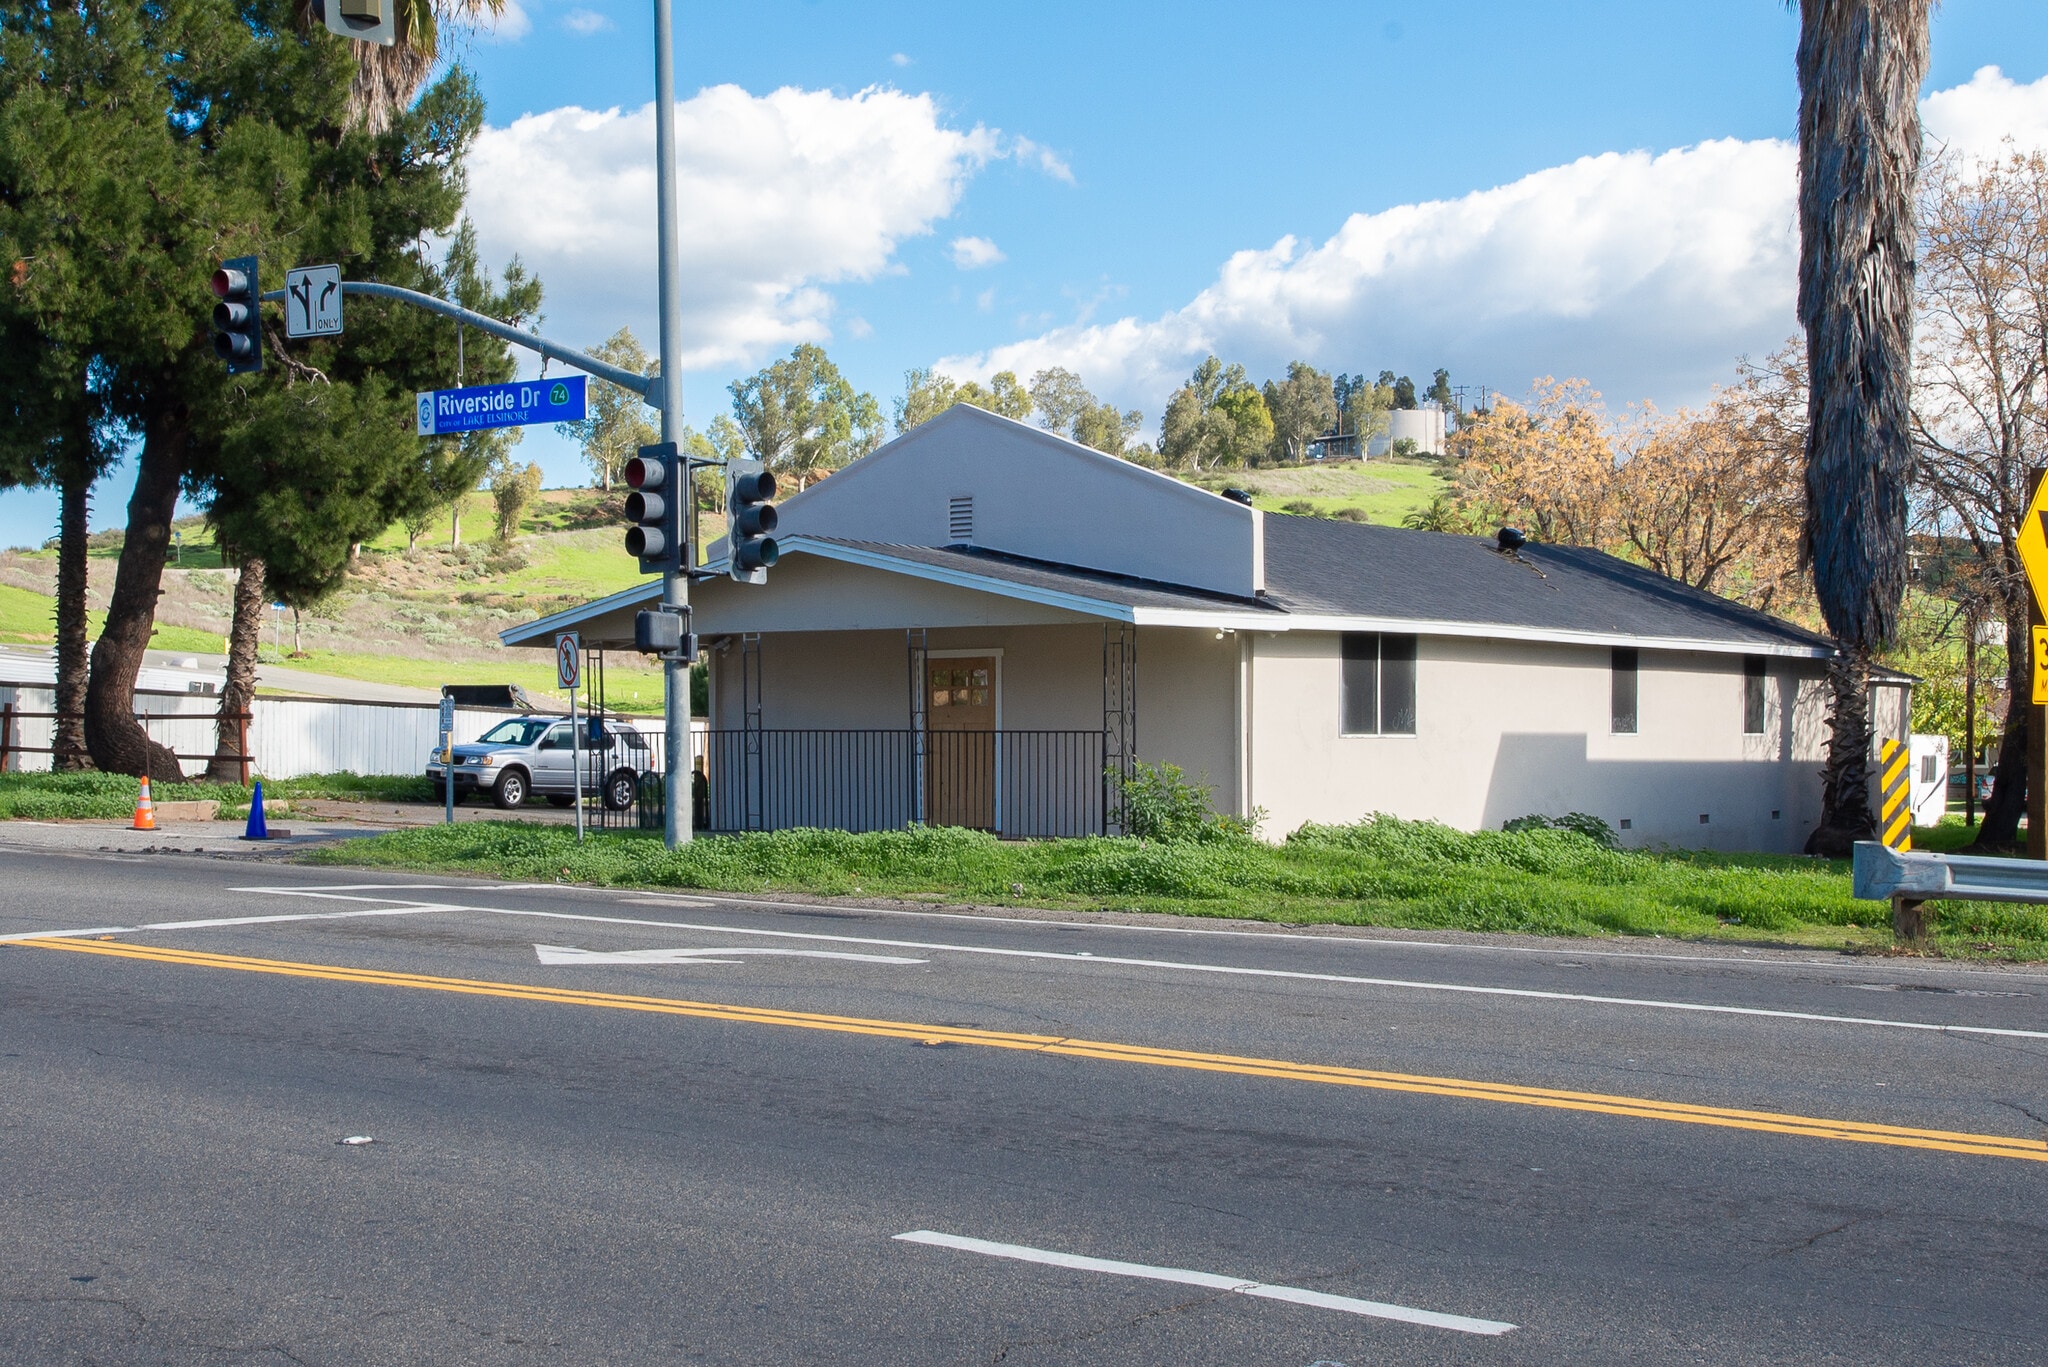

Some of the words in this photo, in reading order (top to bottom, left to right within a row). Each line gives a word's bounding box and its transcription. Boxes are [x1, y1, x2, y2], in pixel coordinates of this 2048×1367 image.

[318, 318, 339, 330] ONLY
[438, 390, 515, 416] Riverside
[521, 387, 540, 408] Dr
[553, 390, 565, 401] 74
[439, 420, 452, 428] CITY
[463, 414, 485, 426] LAKE
[487, 410, 529, 424] ELSINORE
